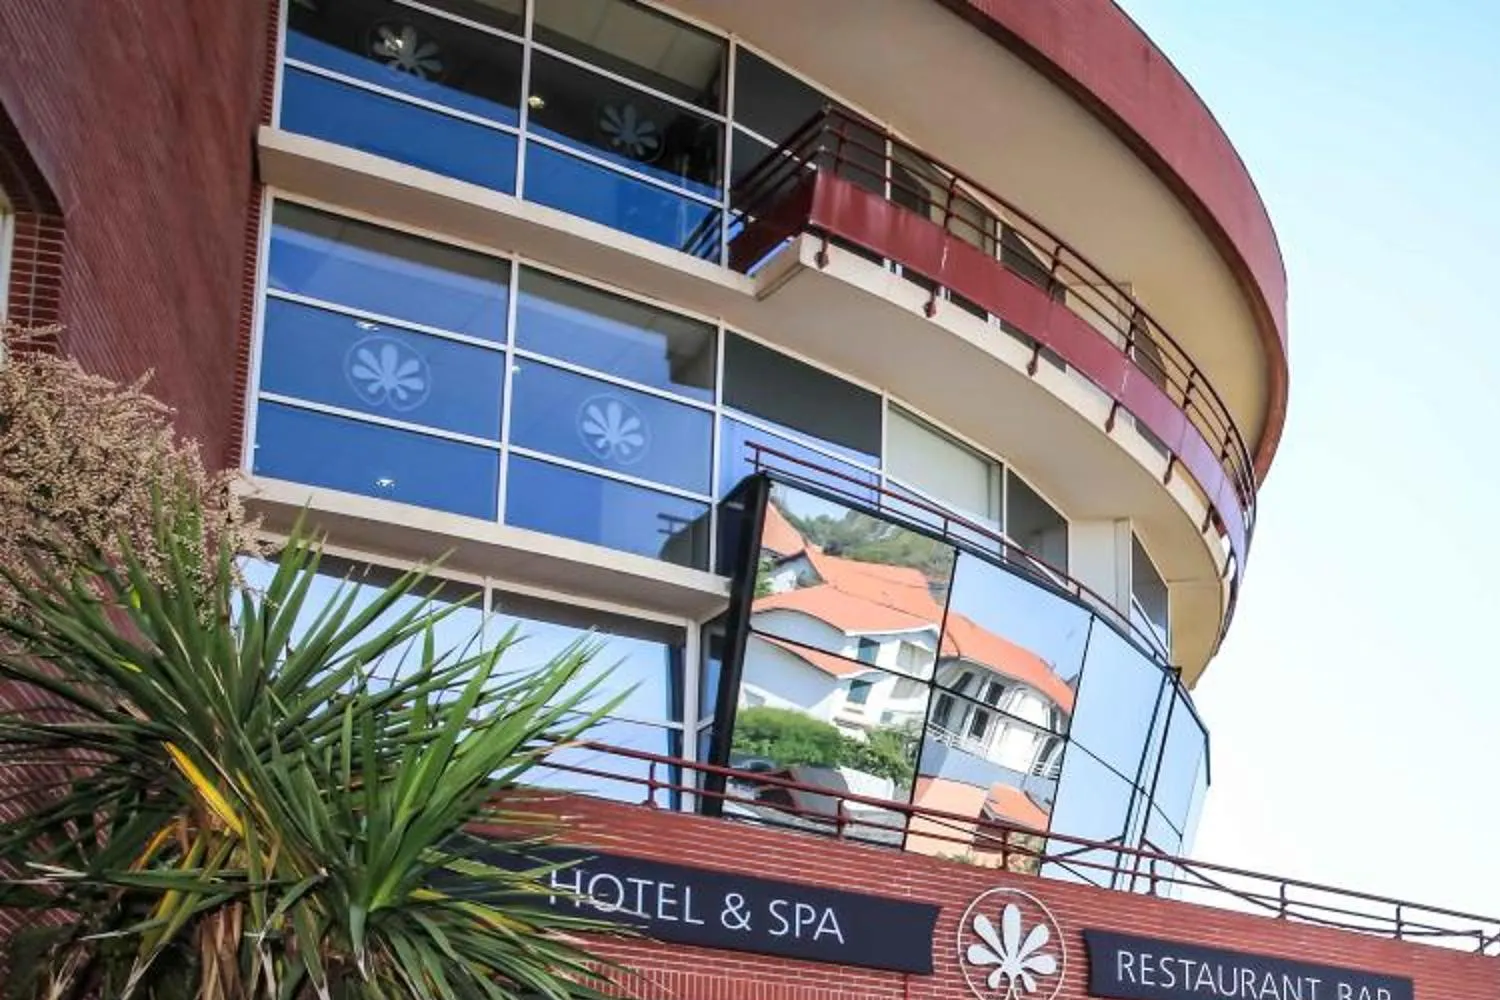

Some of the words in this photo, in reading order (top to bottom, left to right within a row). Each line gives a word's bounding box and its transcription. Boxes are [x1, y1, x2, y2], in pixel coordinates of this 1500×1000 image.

[550, 868, 704, 925] HOTEL
[720, 892, 751, 931] &
[768, 899, 844, 945] SPA
